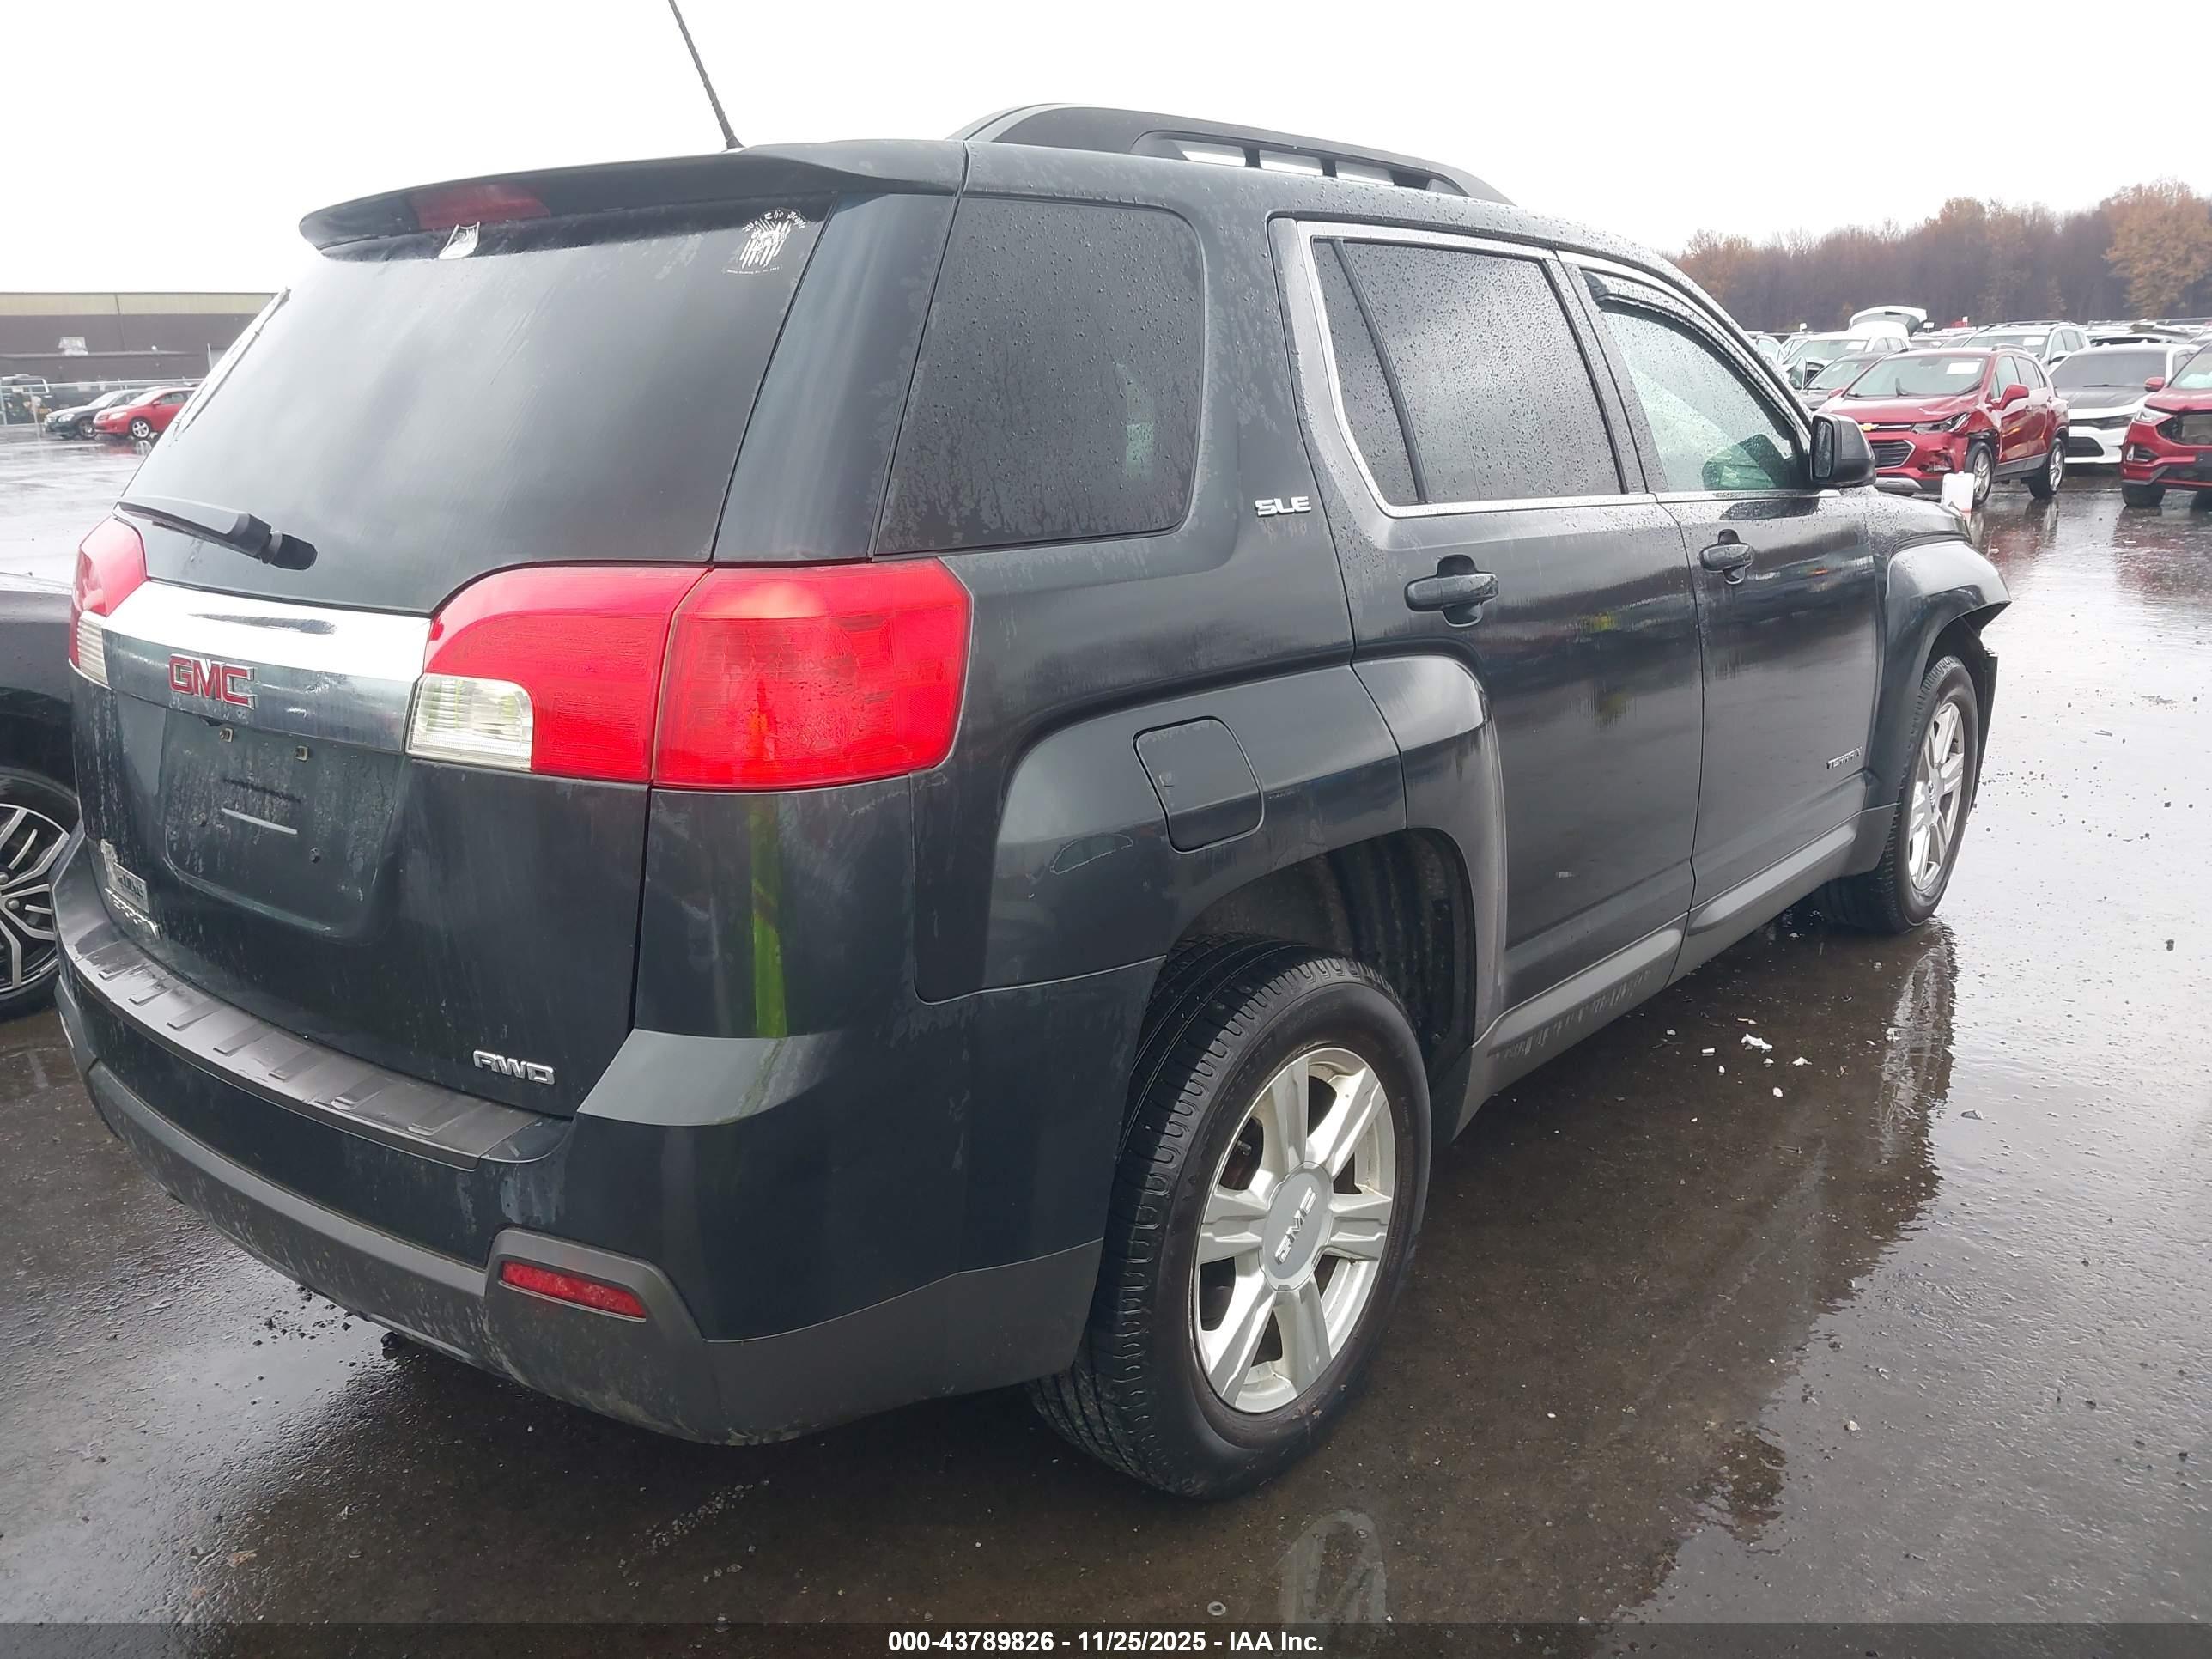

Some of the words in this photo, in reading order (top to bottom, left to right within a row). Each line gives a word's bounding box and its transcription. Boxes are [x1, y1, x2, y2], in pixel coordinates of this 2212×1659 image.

[1255, 495, 1312, 518] SLE
[168, 653, 257, 710] GMC
[472, 1048, 556, 1086] AWD
[1274, 1186, 1317, 1266] GMC
